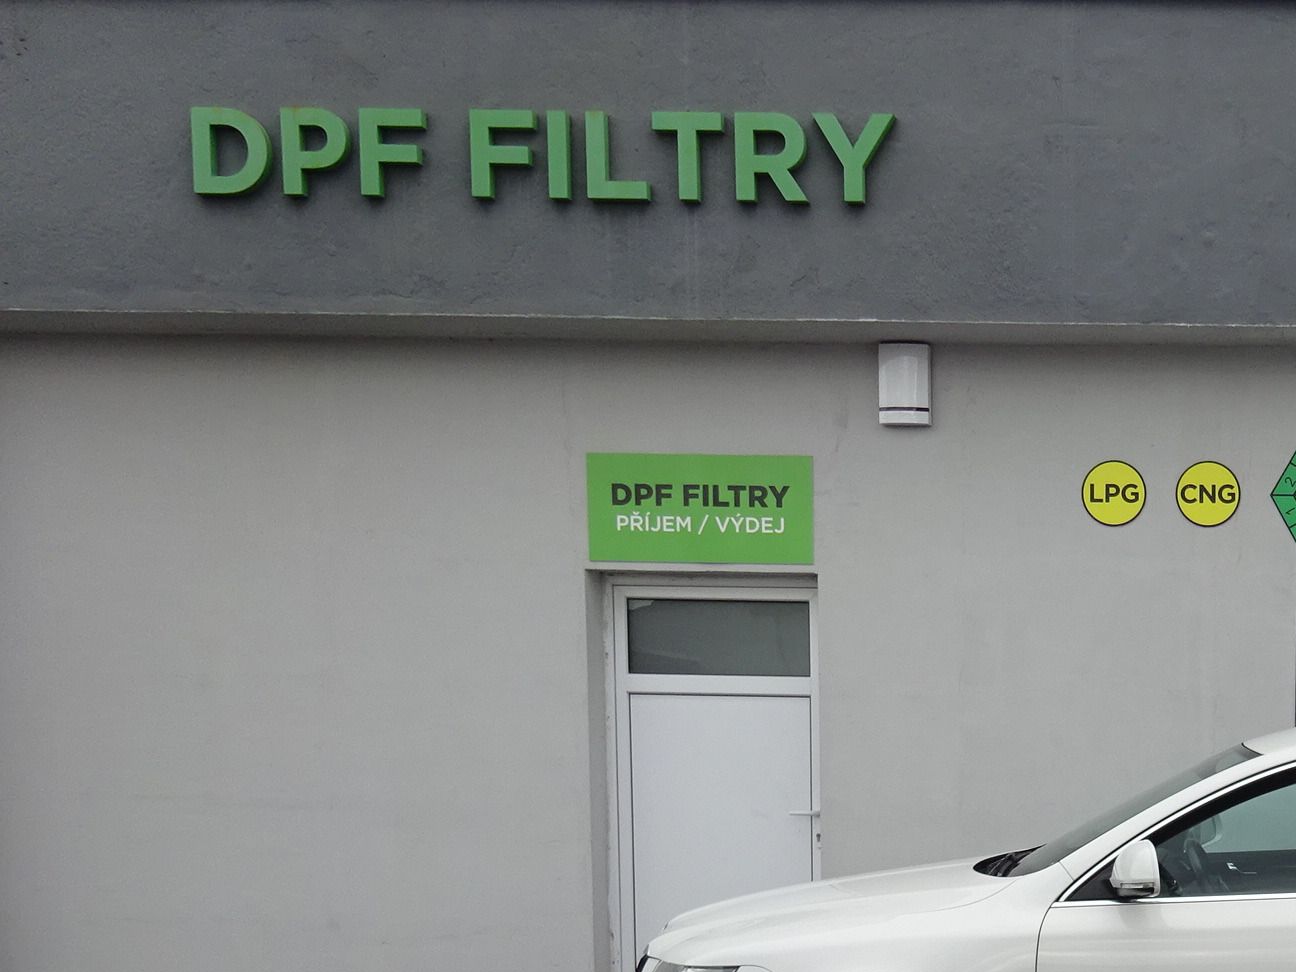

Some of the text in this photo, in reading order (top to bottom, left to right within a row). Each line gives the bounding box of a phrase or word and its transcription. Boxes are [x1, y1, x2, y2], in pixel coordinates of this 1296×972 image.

[190, 106, 898, 205] DPF FILTRY
[1284, 476, 1296, 487] 2
[611, 483, 790, 508] DPF FILTRY
[1089, 483, 1140, 504] LPG
[1180, 484, 1236, 504] CNG
[616, 511, 785, 535] PŘÍJEM / VÝDEJ
